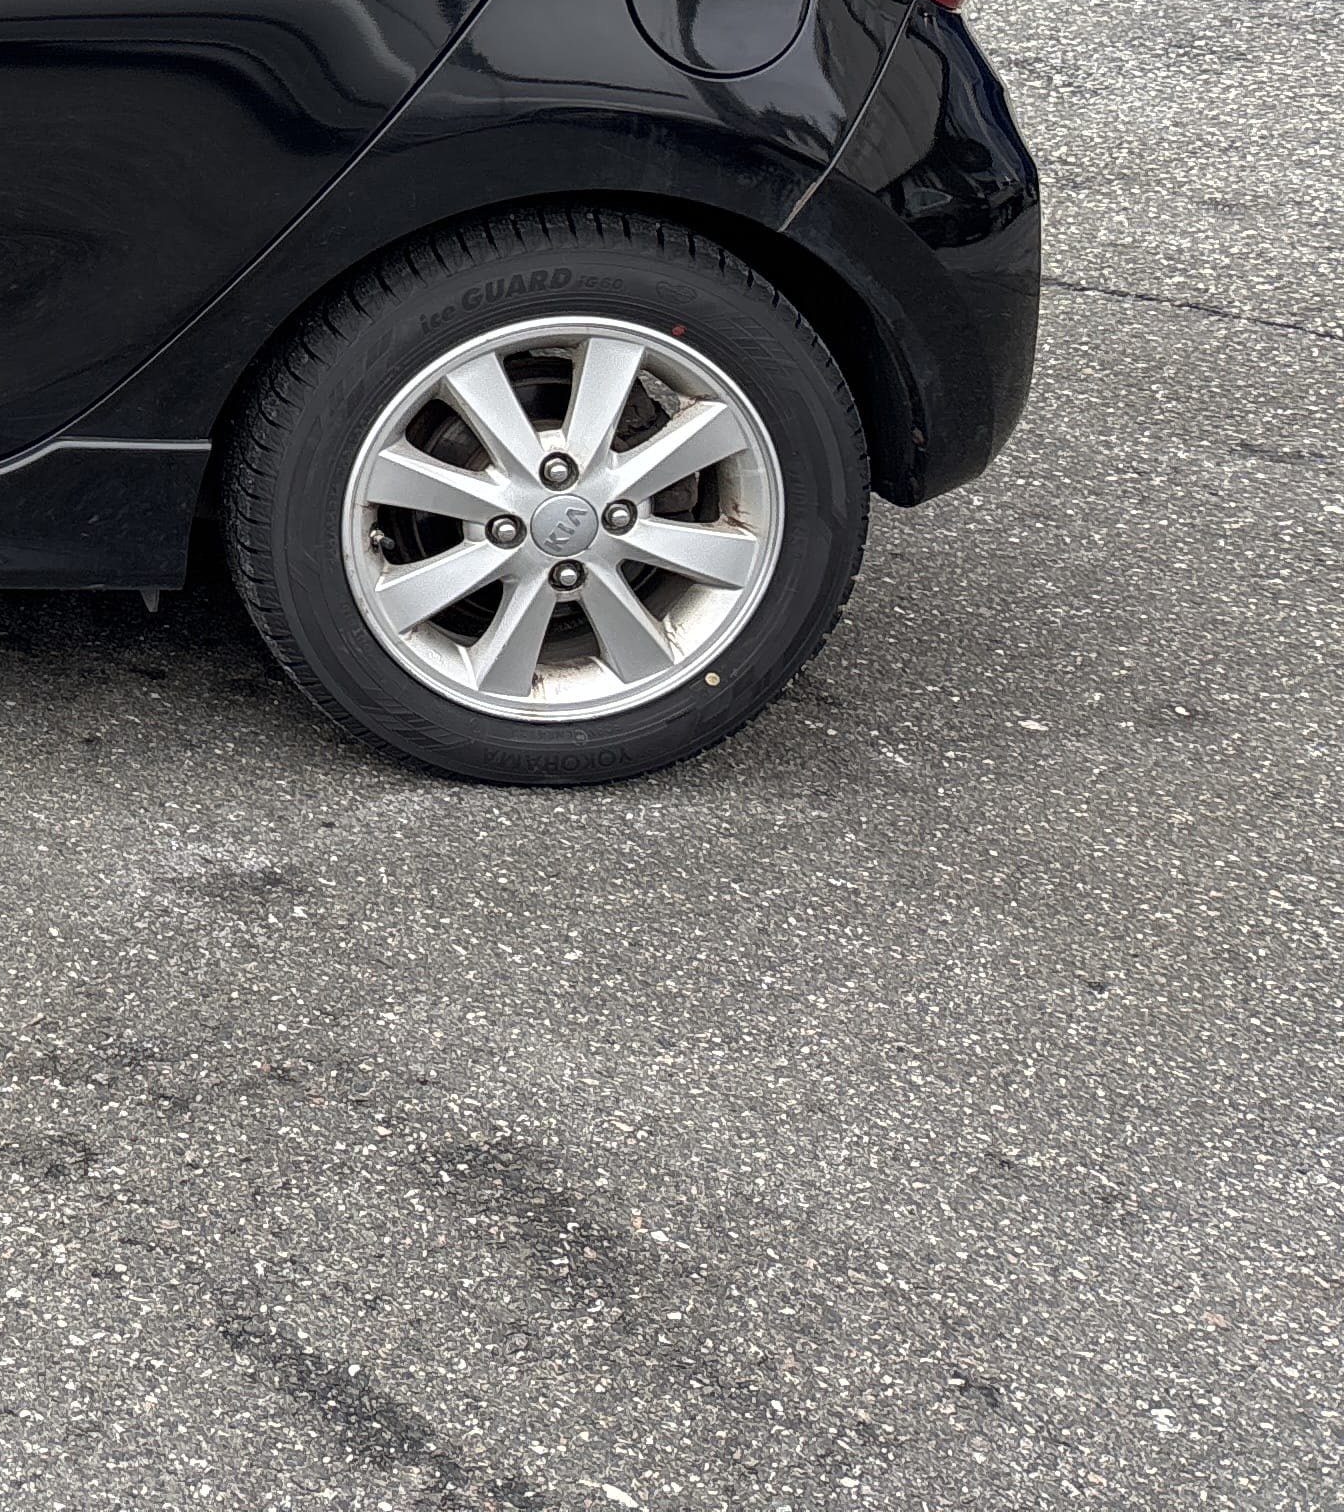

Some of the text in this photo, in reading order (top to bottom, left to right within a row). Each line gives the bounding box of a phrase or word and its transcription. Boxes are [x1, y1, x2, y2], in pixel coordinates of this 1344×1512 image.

[419, 304, 458, 334] ice
[461, 266, 574, 310] GUARD
[544, 507, 589, 552] KIA
